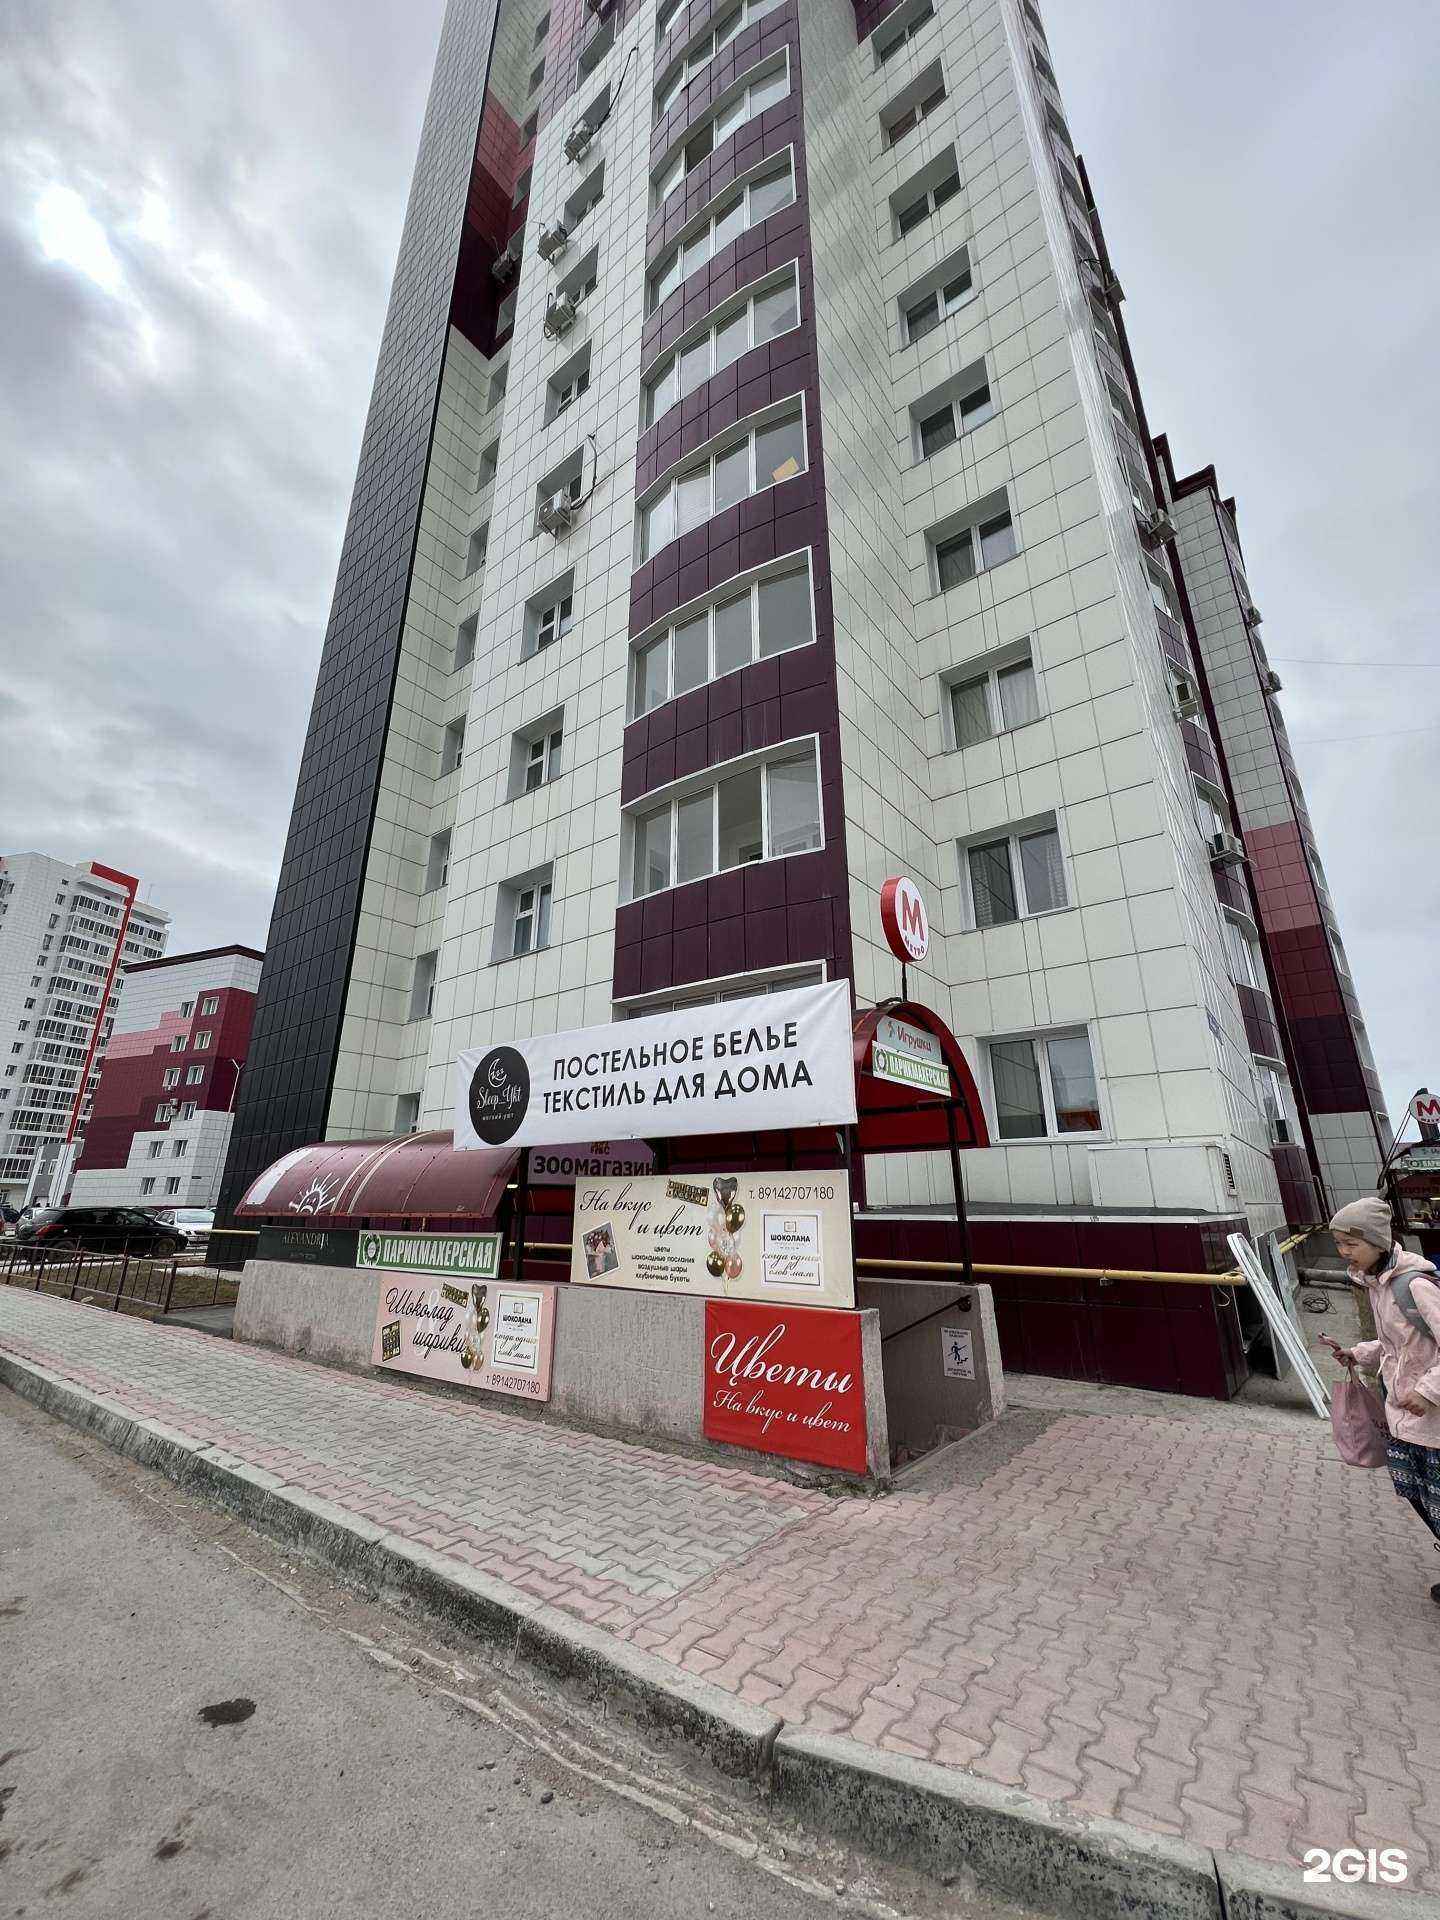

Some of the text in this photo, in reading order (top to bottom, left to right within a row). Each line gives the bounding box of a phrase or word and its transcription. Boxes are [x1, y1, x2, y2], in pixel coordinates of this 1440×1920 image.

[902, 889, 925, 942] М
[904, 935, 925, 955] МЕТРО
[553, 1021, 798, 1081] ПОСТЕЛЬНОЕ БЕЛЬЕ
[543, 1059, 813, 1114] ТЕКСТИЛЬ ДЛЯ ДОМА
[889, 1056, 950, 1089] ПАРИКМАХЕРСКАЯ
[580, 1189, 610, 1211] На
[613, 1183, 653, 1230] вкус
[758, 1186, 834, 1200] 89142707180
[637, 1205, 703, 1238] и цвет
[770, 1234, 811, 1243] ШОКОЛАНА
[383, 1238, 495, 1269] ПАРИКМАХЕРСКАЯ
[386, 1287, 454, 1331] Шоколад
[412, 1324, 467, 1359] шарики
[711, 1324, 853, 1393] Цветы
[491, 1374, 541, 1394] 89142707180
[713, 1390, 851, 1434] На вкус и цвет
